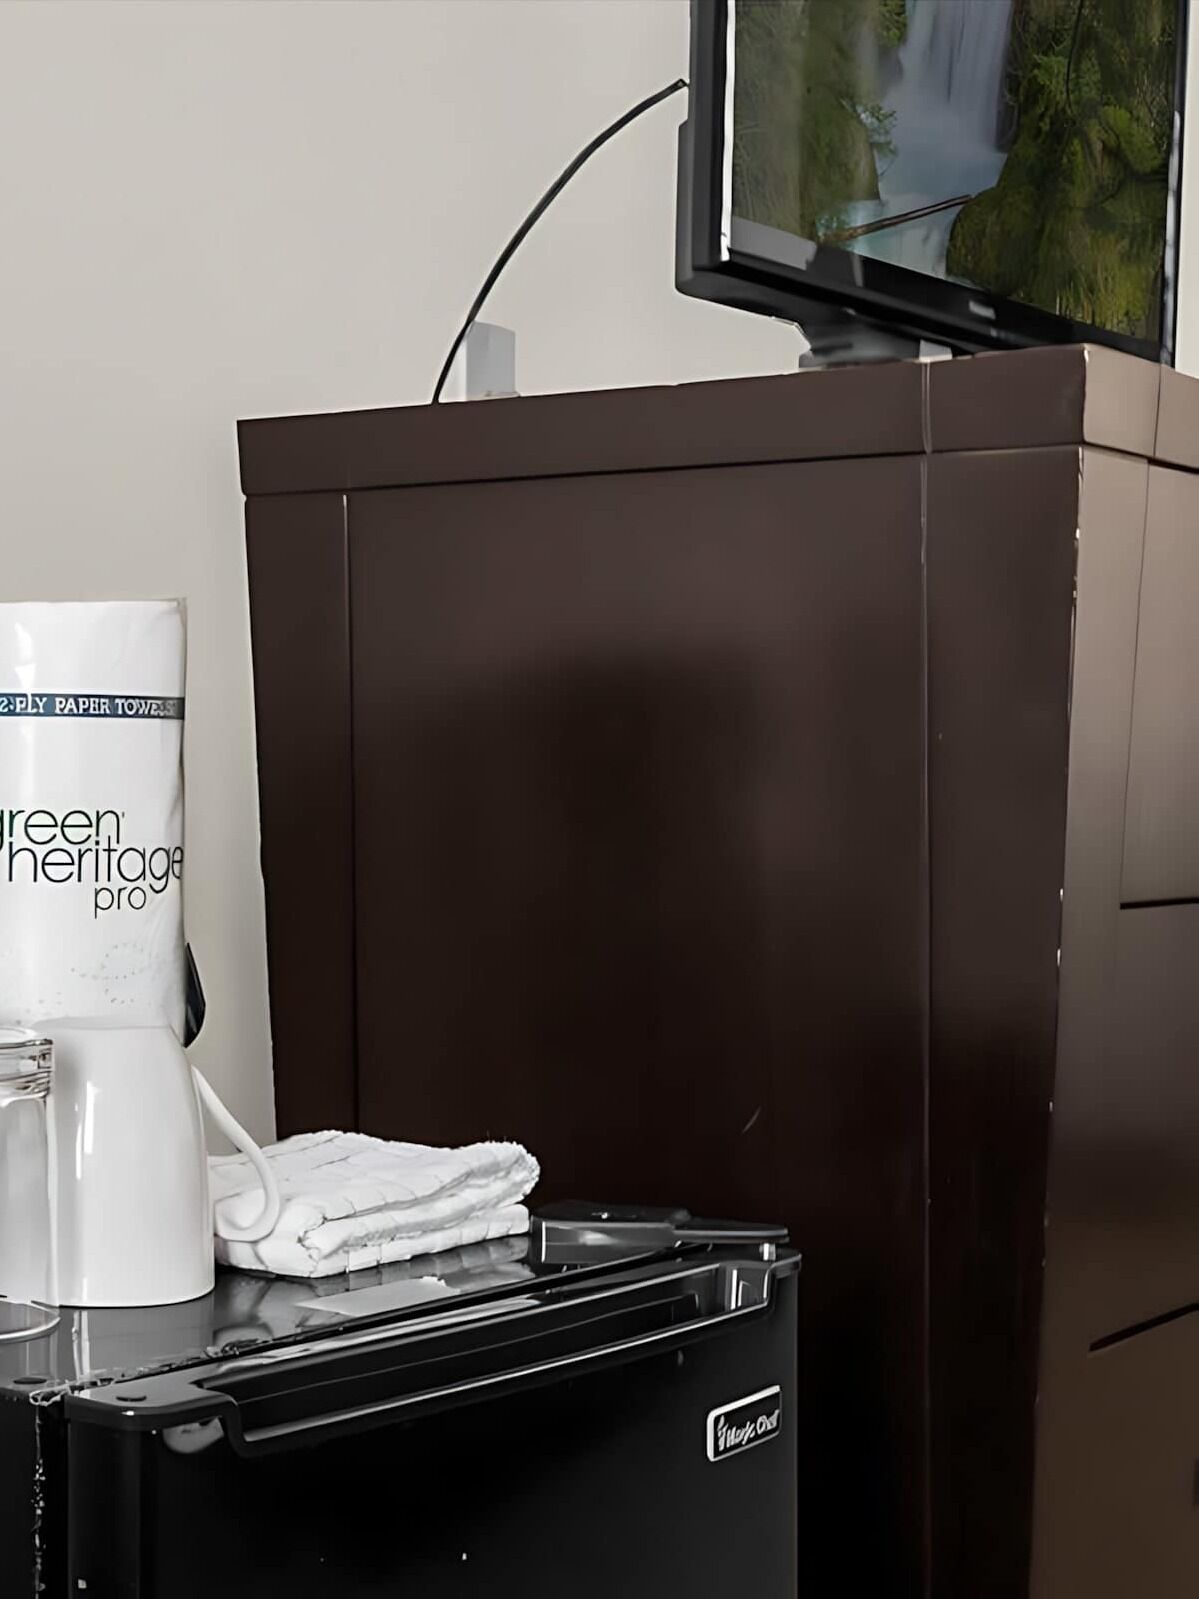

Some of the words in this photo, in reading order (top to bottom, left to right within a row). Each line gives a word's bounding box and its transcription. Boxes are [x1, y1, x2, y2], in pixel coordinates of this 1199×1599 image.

[54, 697, 112, 714] PAPER
[8, 835, 184, 894] heritage
[94, 886, 146, 919] pro
